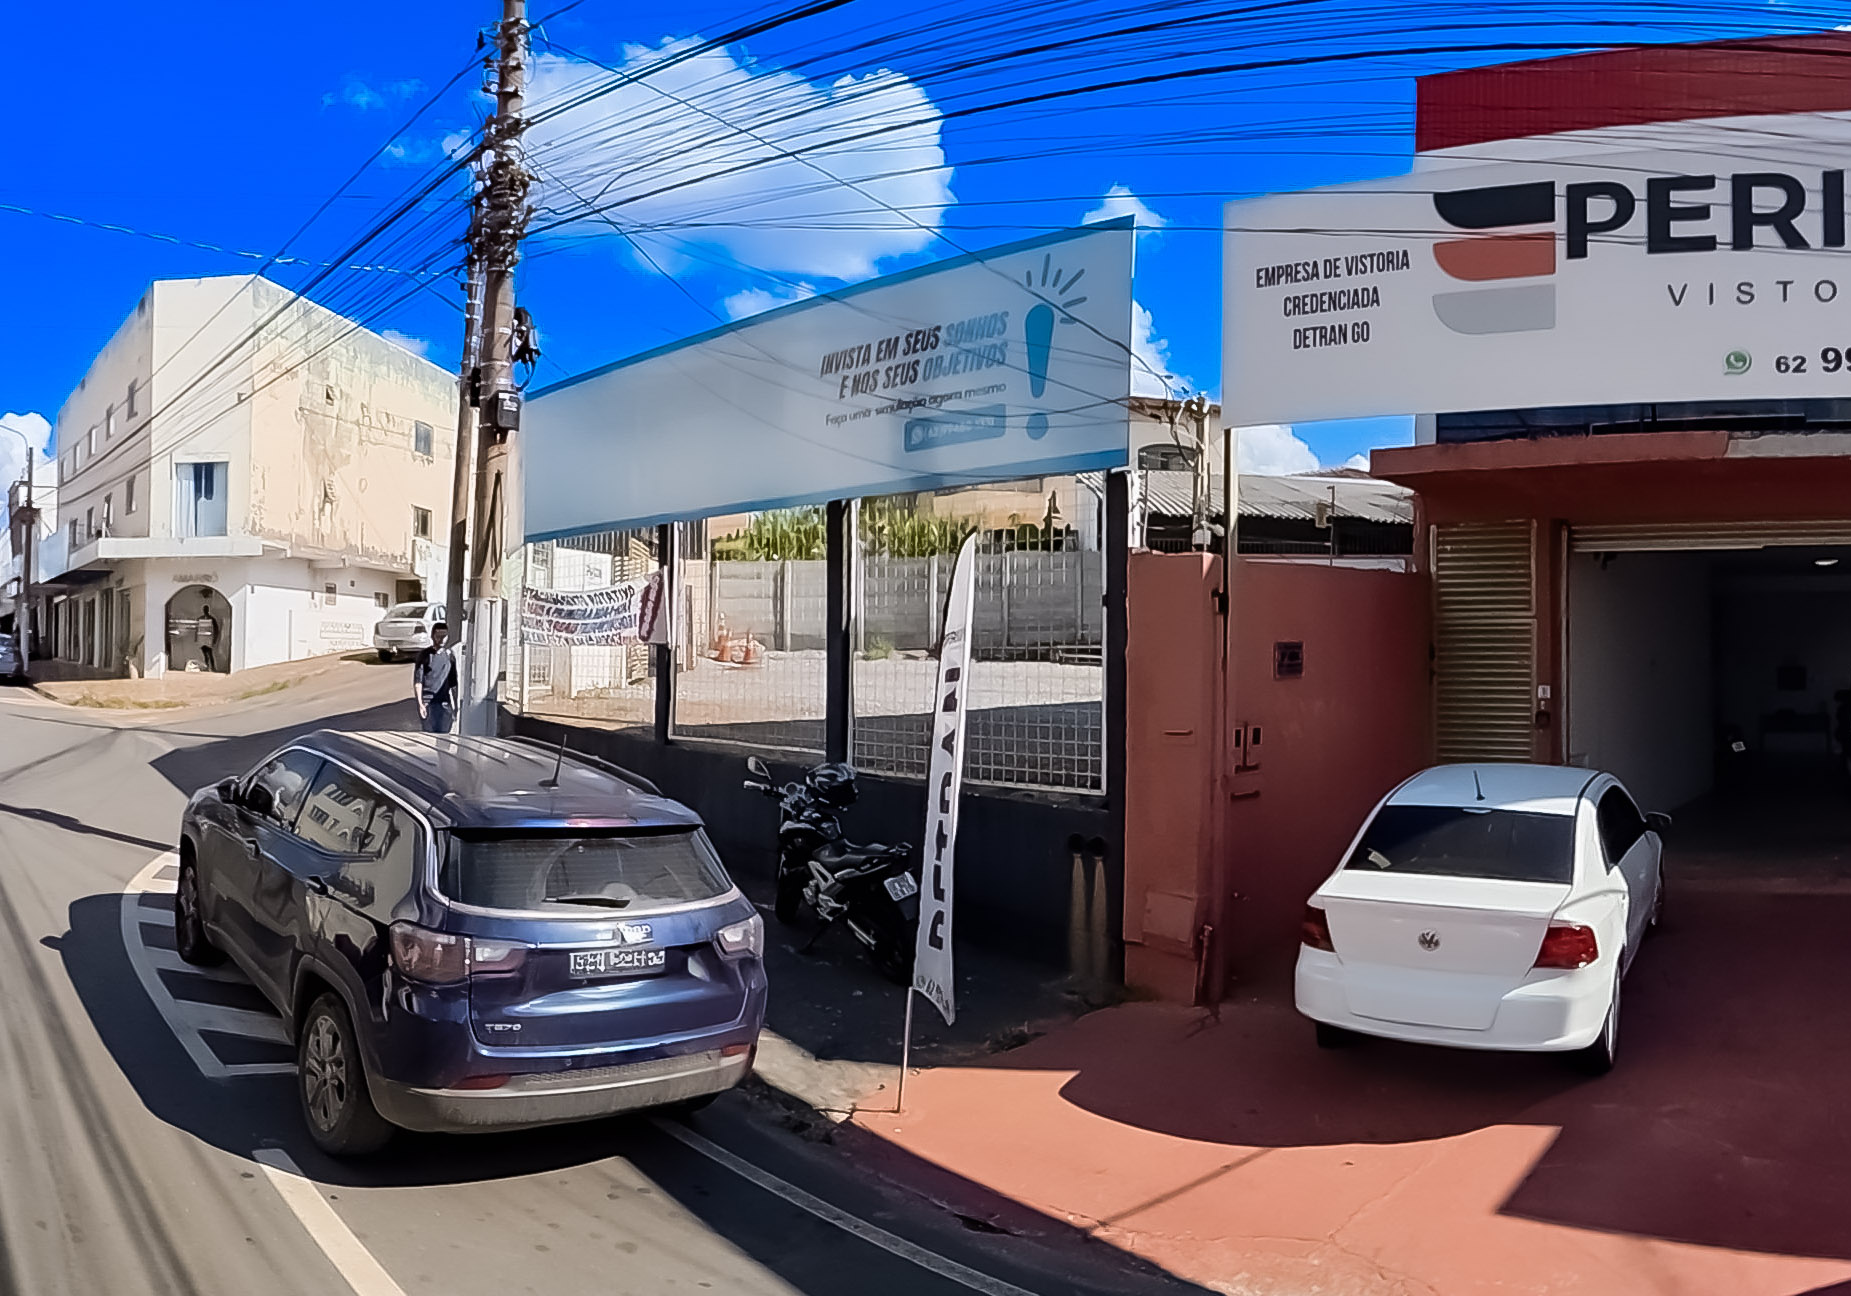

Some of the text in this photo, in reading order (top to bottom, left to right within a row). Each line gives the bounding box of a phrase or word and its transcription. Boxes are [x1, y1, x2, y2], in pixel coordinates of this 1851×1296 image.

[1256, 249, 1410, 288] EMPRESA DE VISTORIA
[1283, 286, 1381, 317] CREDENCIADA
[820, 311, 1009, 378] INVISTA EM SEUS SONHOS
[1293, 321, 1370, 349] DETRAN GO
[839, 342, 1009, 400] E NOS SEUS OBJETIVOS
[1775, 355, 1807, 374] 62
